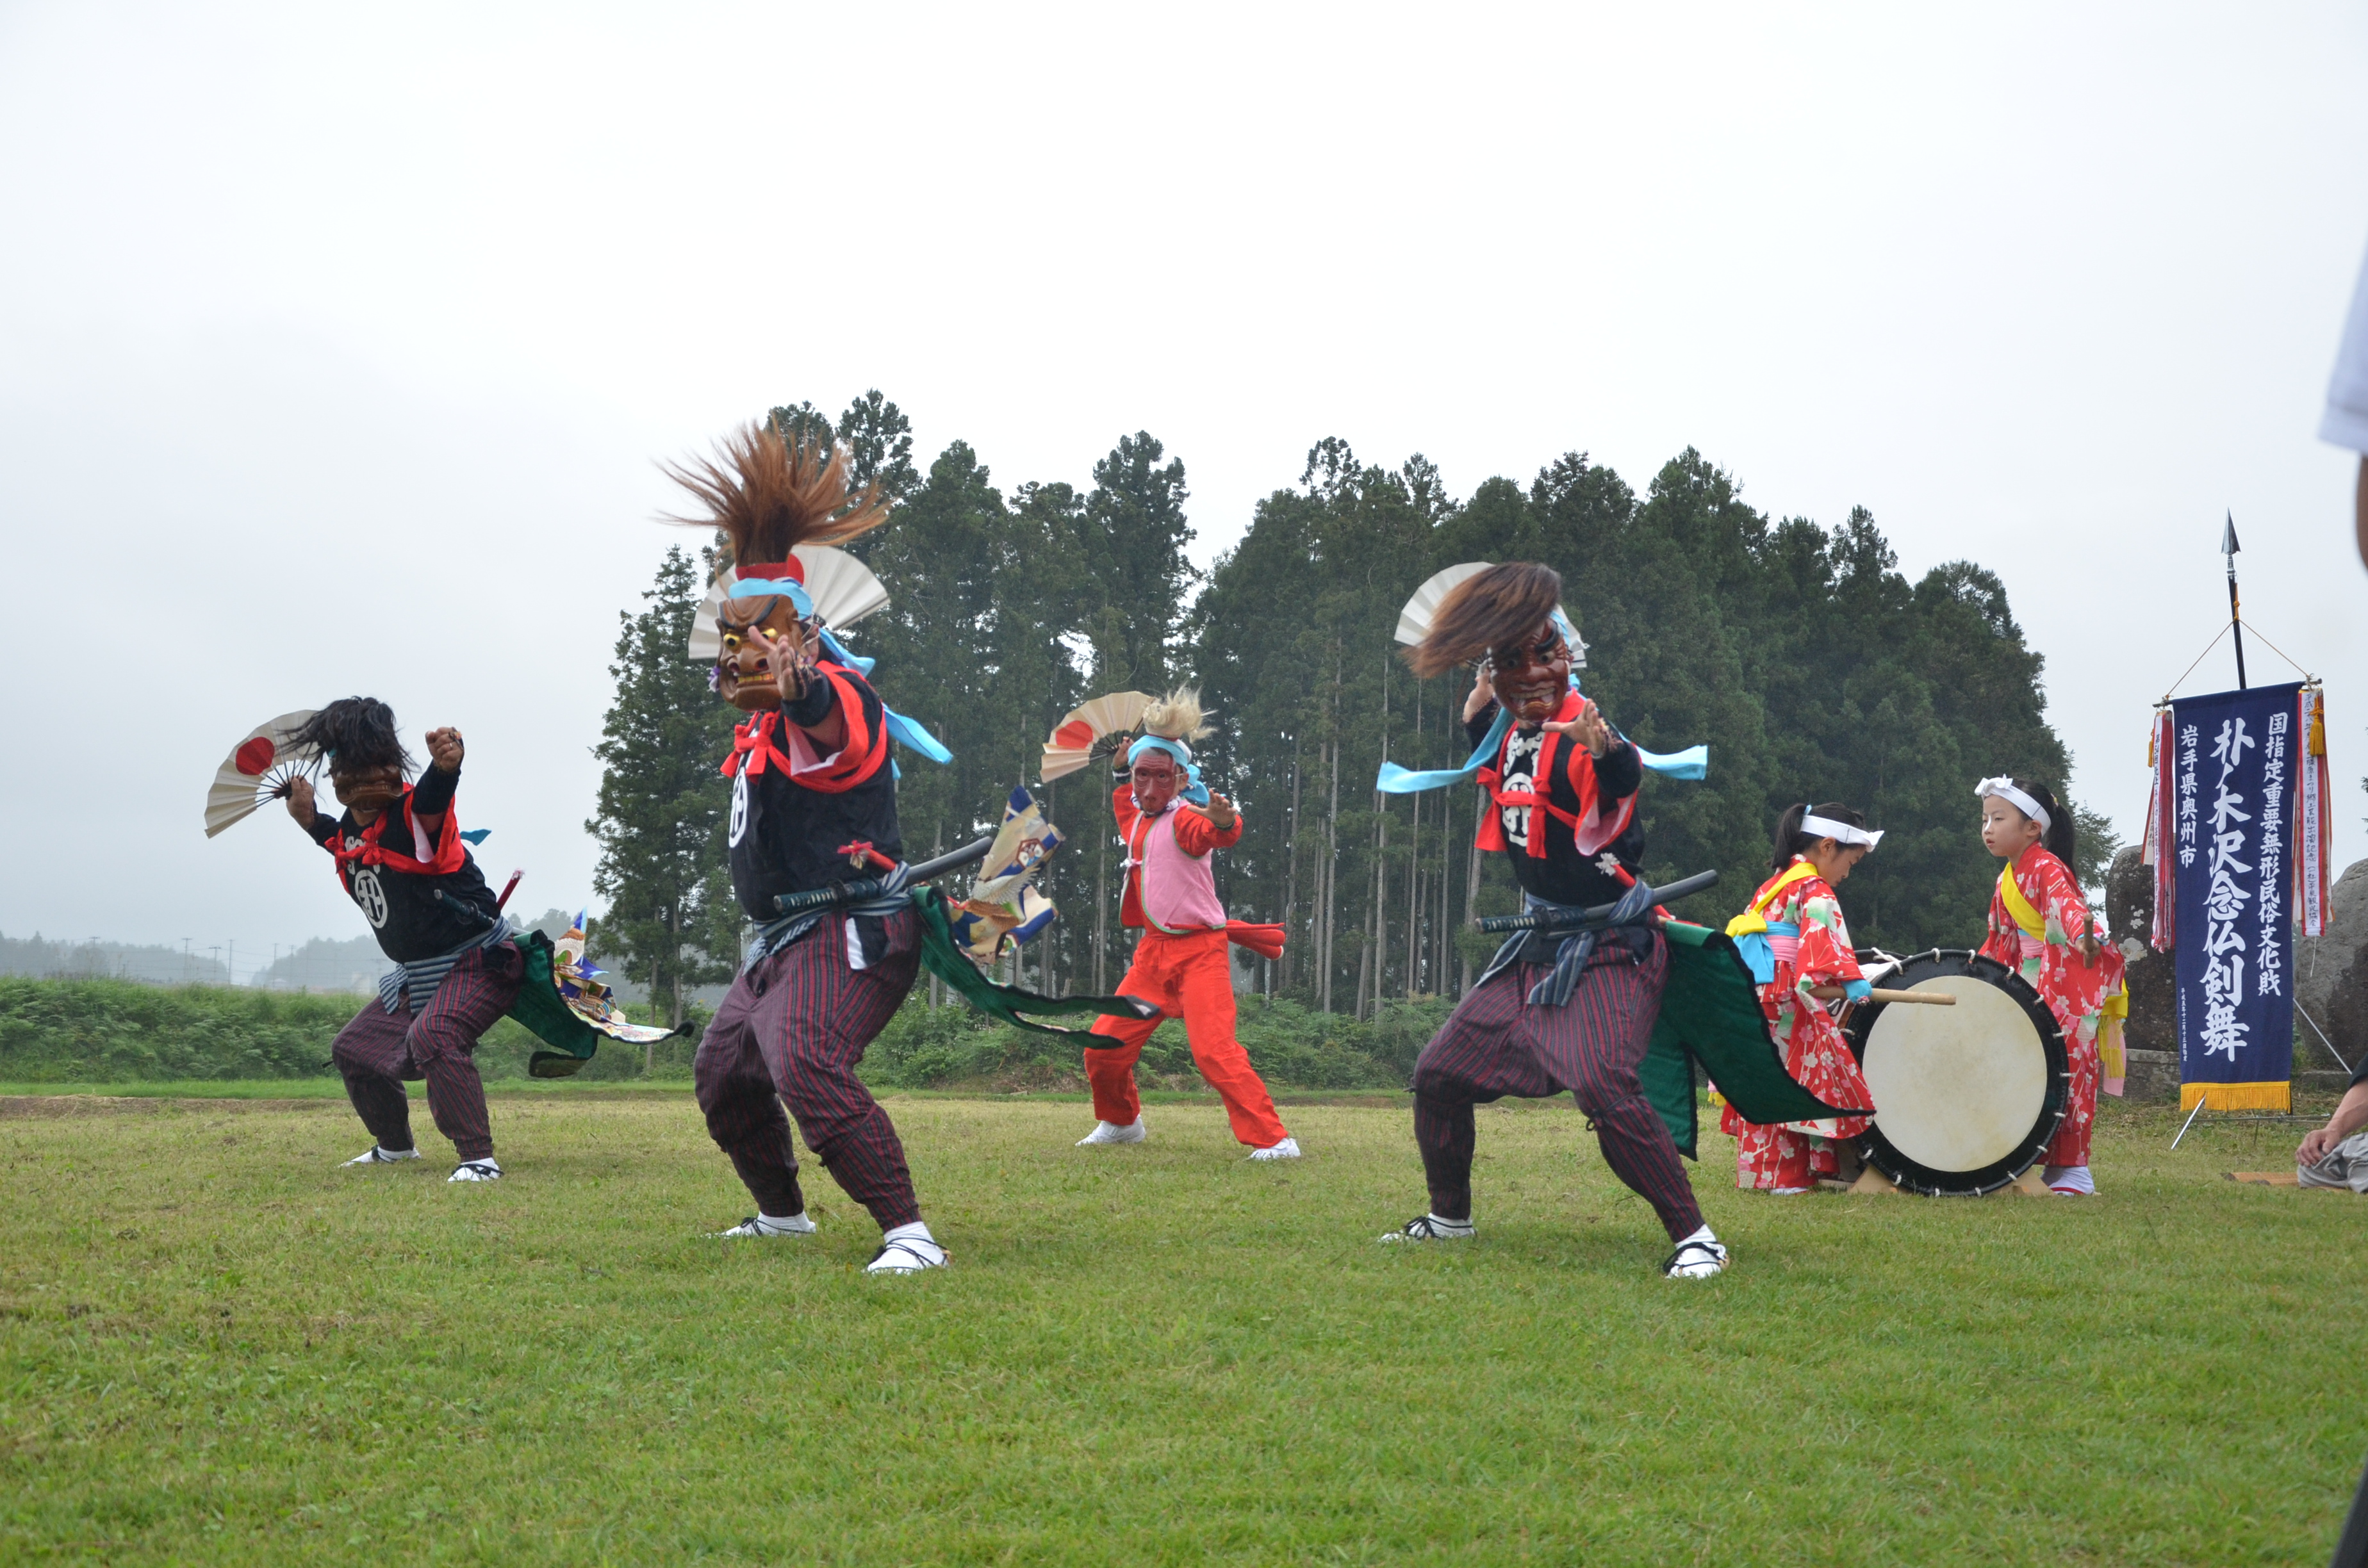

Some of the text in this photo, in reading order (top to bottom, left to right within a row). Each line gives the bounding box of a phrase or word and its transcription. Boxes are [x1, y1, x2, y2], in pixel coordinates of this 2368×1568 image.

[2180, 724, 2198, 868] 岩手県奥州市
[2199, 717, 2255, 1062] 朴ノ木沢念仏剣舞
[2257, 712, 2288, 996] 国指定重要無形民俗文化財
